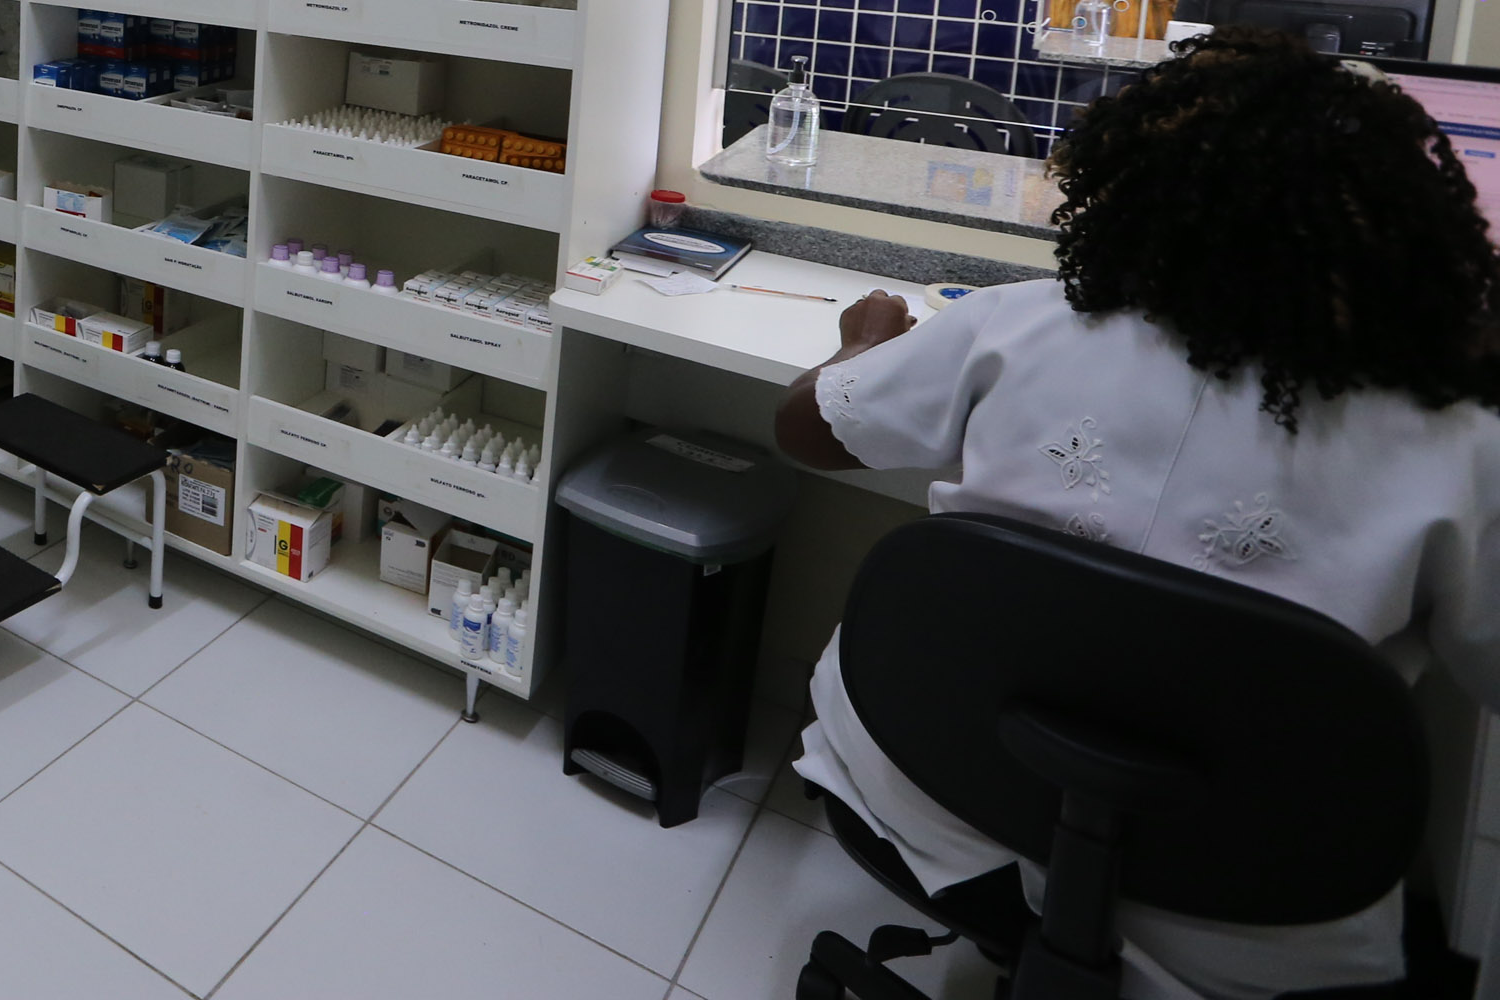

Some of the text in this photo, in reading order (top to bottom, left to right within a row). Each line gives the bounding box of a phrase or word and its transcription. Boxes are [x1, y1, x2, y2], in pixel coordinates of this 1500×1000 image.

[312, 150, 345, 159] PARACETAMOL
[462, 173, 499, 184] PARACETAMOL
[286, 290, 315, 301] SALBUTAMOL
[450, 332, 483, 345] SALBUTAMOL
[431, 478, 452, 488] SULFATO
